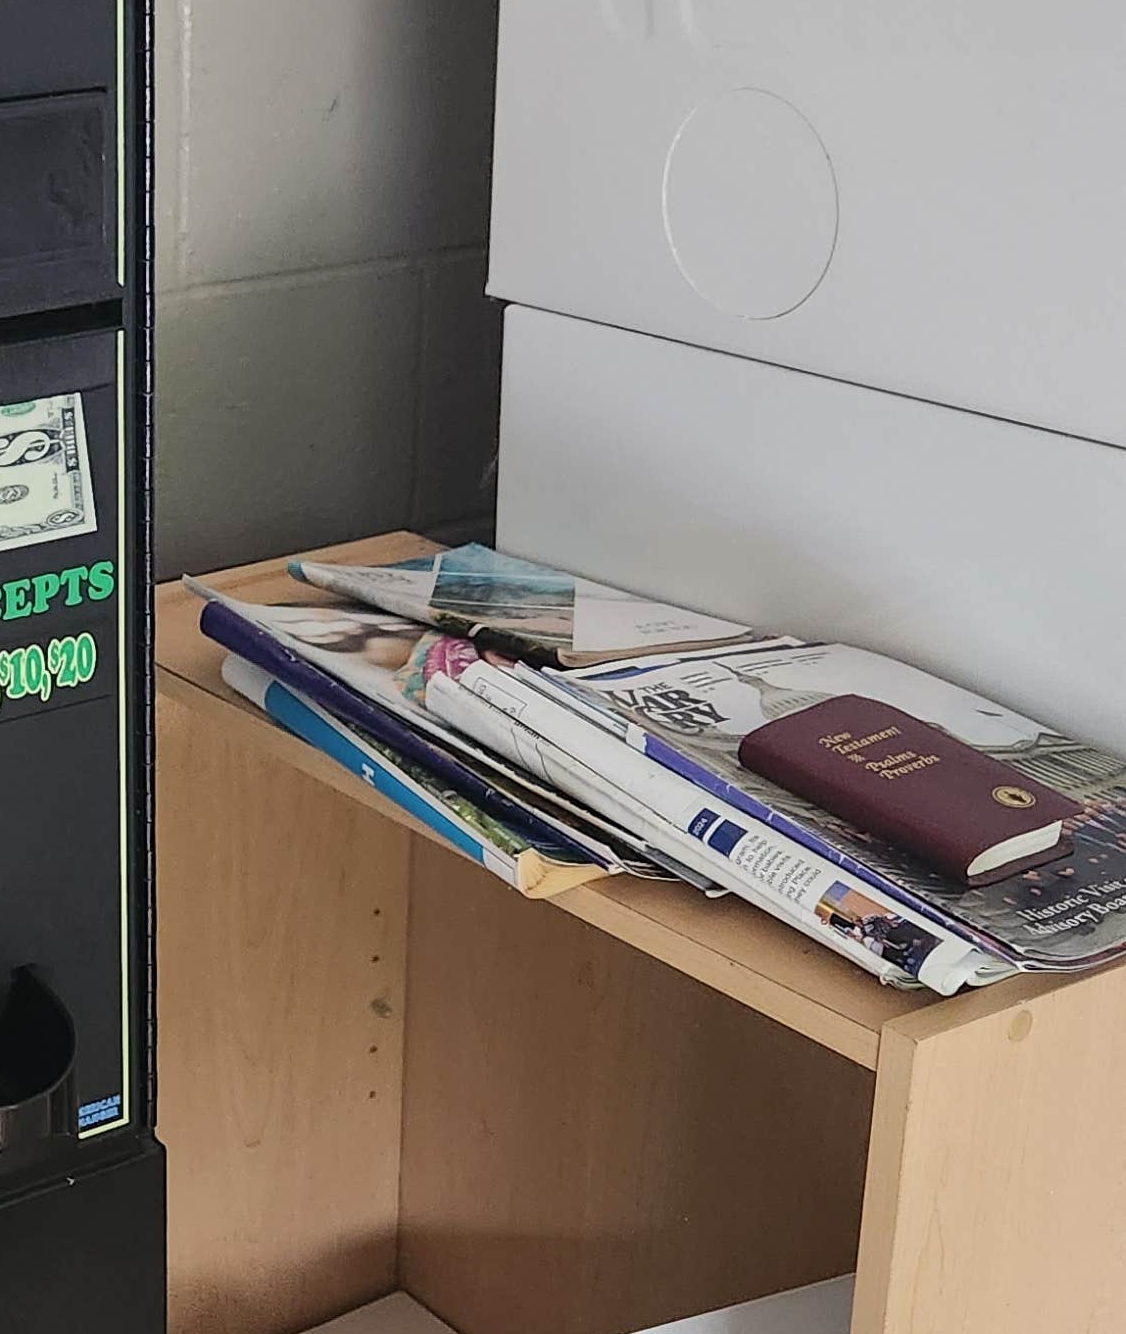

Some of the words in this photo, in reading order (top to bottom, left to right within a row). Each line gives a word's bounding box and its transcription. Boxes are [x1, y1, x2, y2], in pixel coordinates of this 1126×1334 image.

[638, 681, 673, 694] THE
[818, 732, 852, 748] New
[832, 726, 903, 755] Testament
[865, 750, 918, 772] Psalms
[879, 754, 941, 780] Proverbs
[1015, 894, 1089, 921] Historic
[1022, 910, 1099, 935] Advisory
